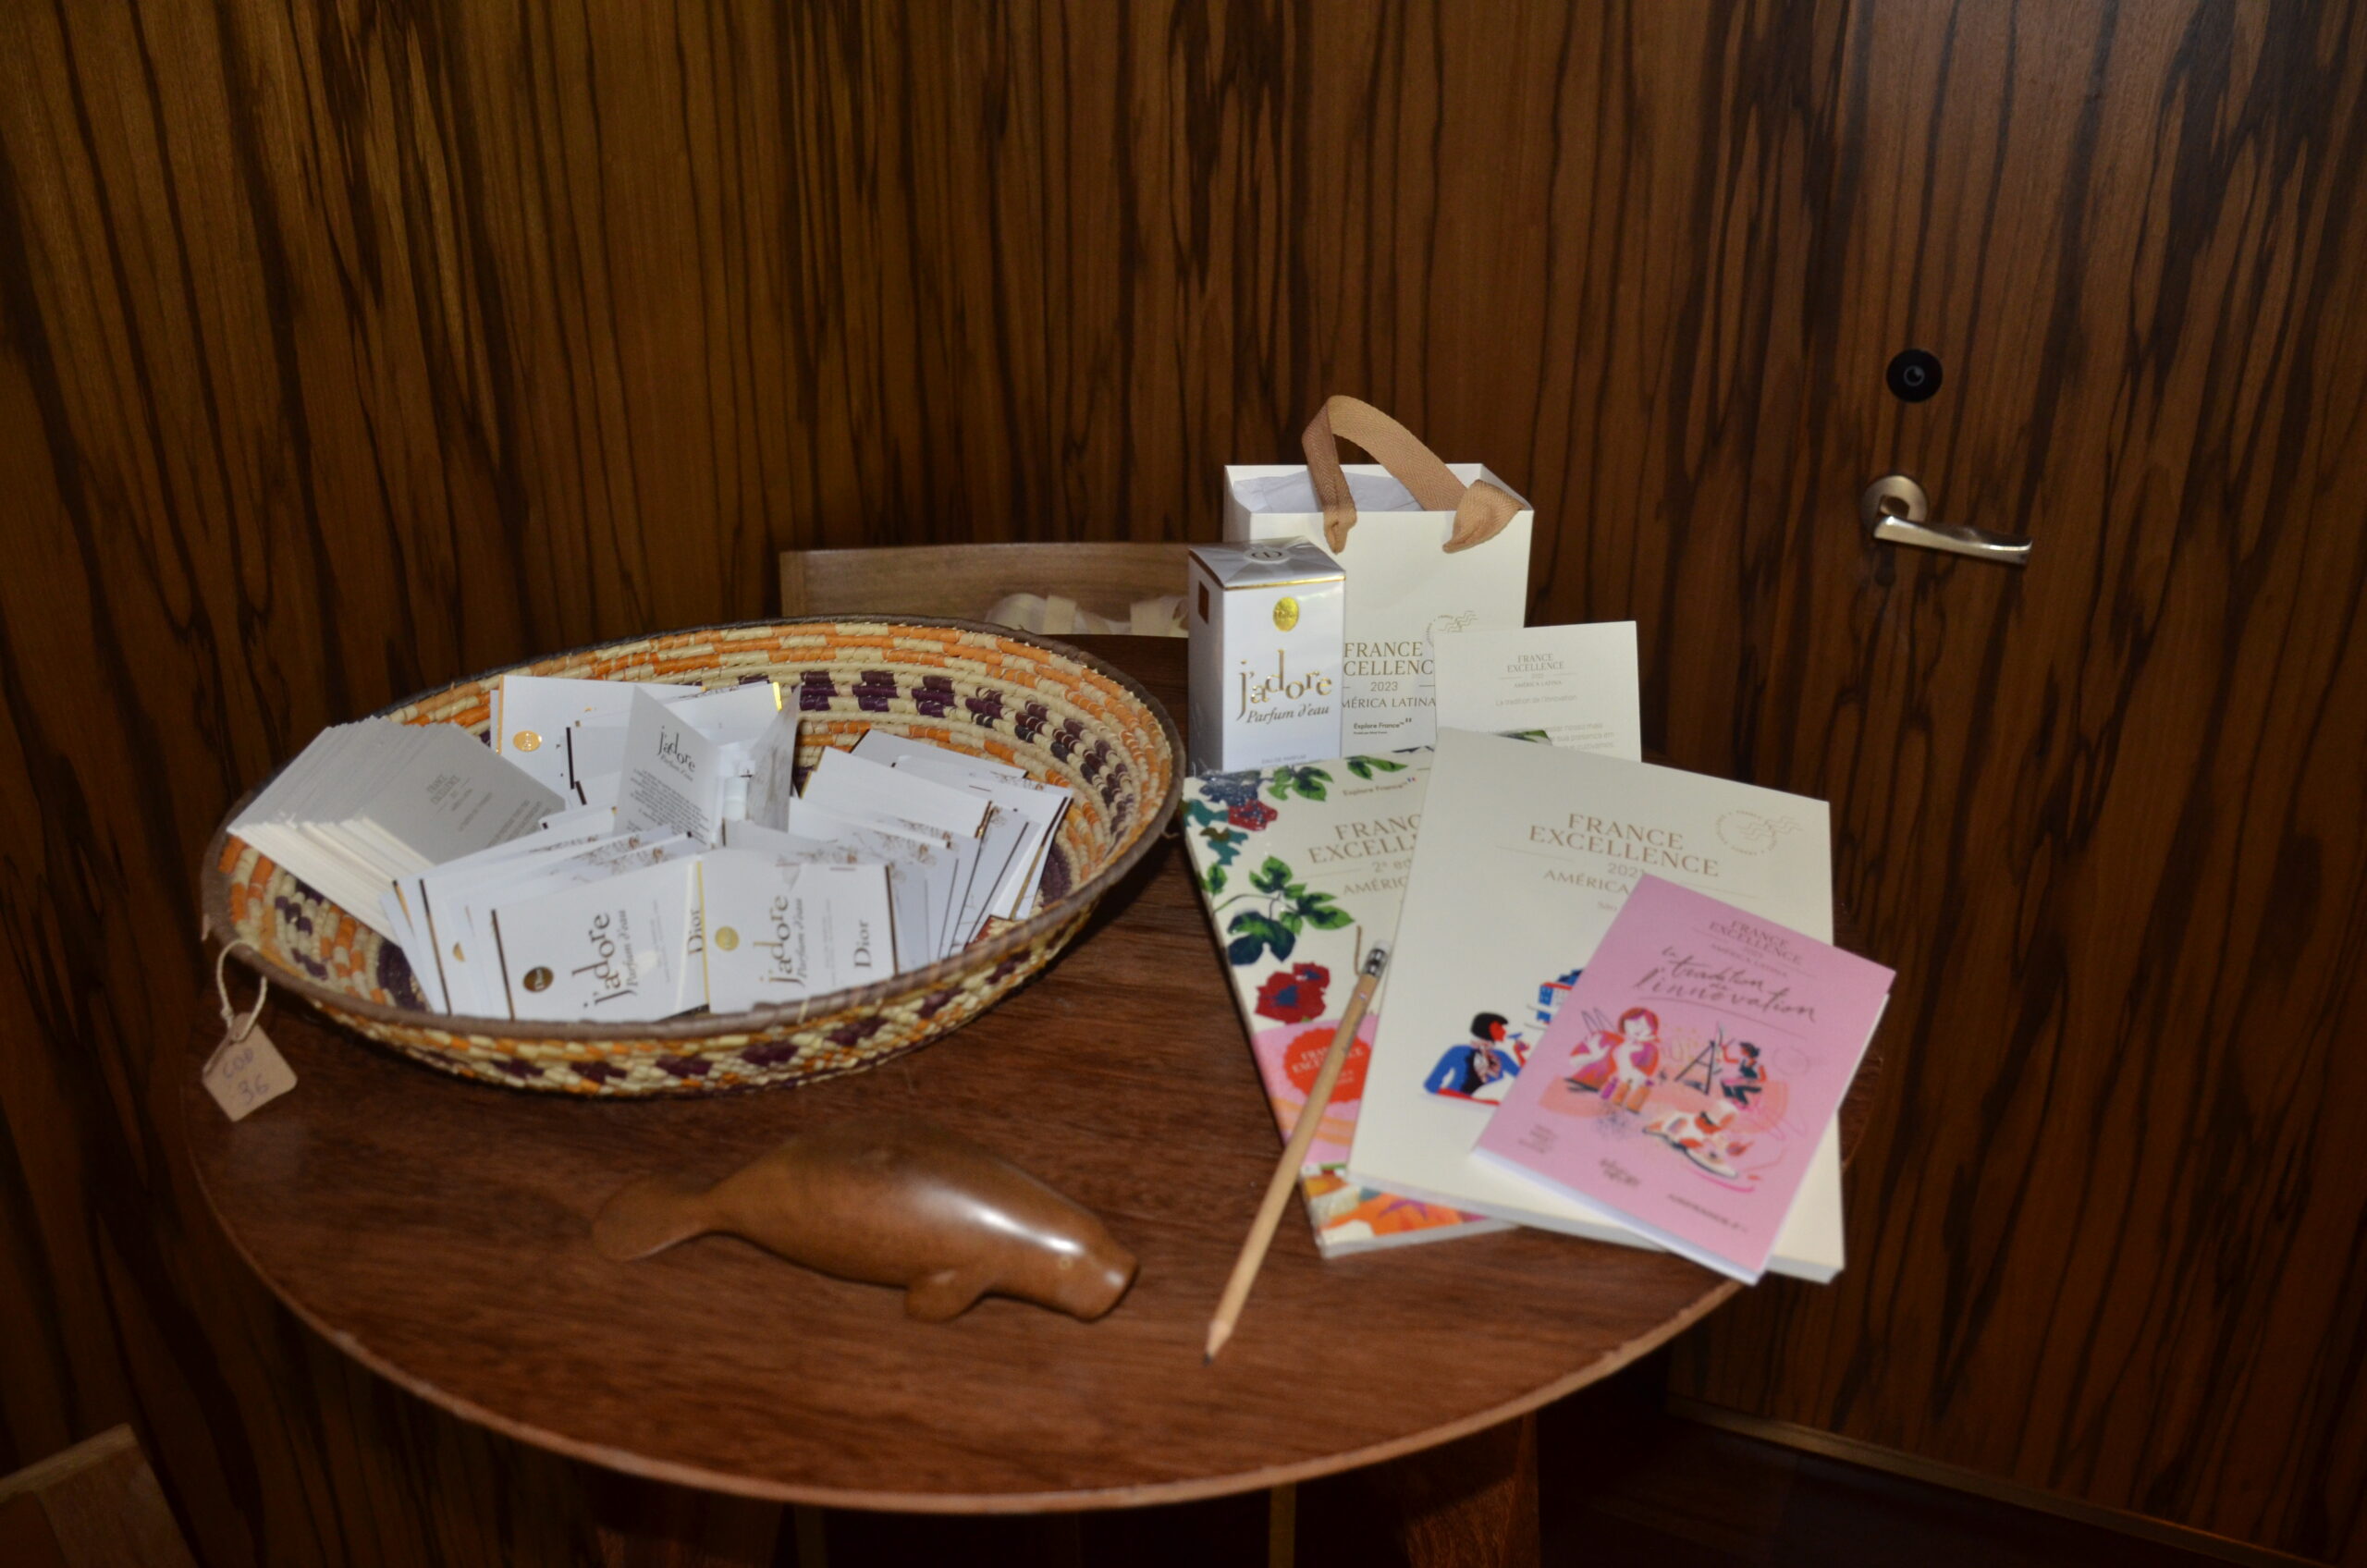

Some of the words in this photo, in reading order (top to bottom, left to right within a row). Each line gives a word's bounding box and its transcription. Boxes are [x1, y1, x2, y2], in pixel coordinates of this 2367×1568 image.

[1343, 641, 1424, 657] FRANCE
[1517, 653, 1554, 664] FRANCE
[1343, 659, 1434, 677] CELLENC
[1507, 660, 1564, 673] EXCELLENCE
[1236, 649, 1332, 721] j'adore
[1370, 681, 1398, 692] 2023
[1342, 696, 1387, 709] MÉRICA
[1392, 696, 1436, 708] LATINA
[1246, 705, 1294, 725] Parfum
[1334, 813, 1421, 840] FRANC
[1567, 813, 1685, 851] FRANCE
[1528, 824, 1720, 877] EXCELLENCE
[1343, 876, 1407, 896] AMÉRIC
[1543, 868, 1630, 896] AMÉRICA
[753, 894, 807, 988] j'adore
[853, 918, 873, 969] Dior
[571, 912, 638, 1009] j'adore
